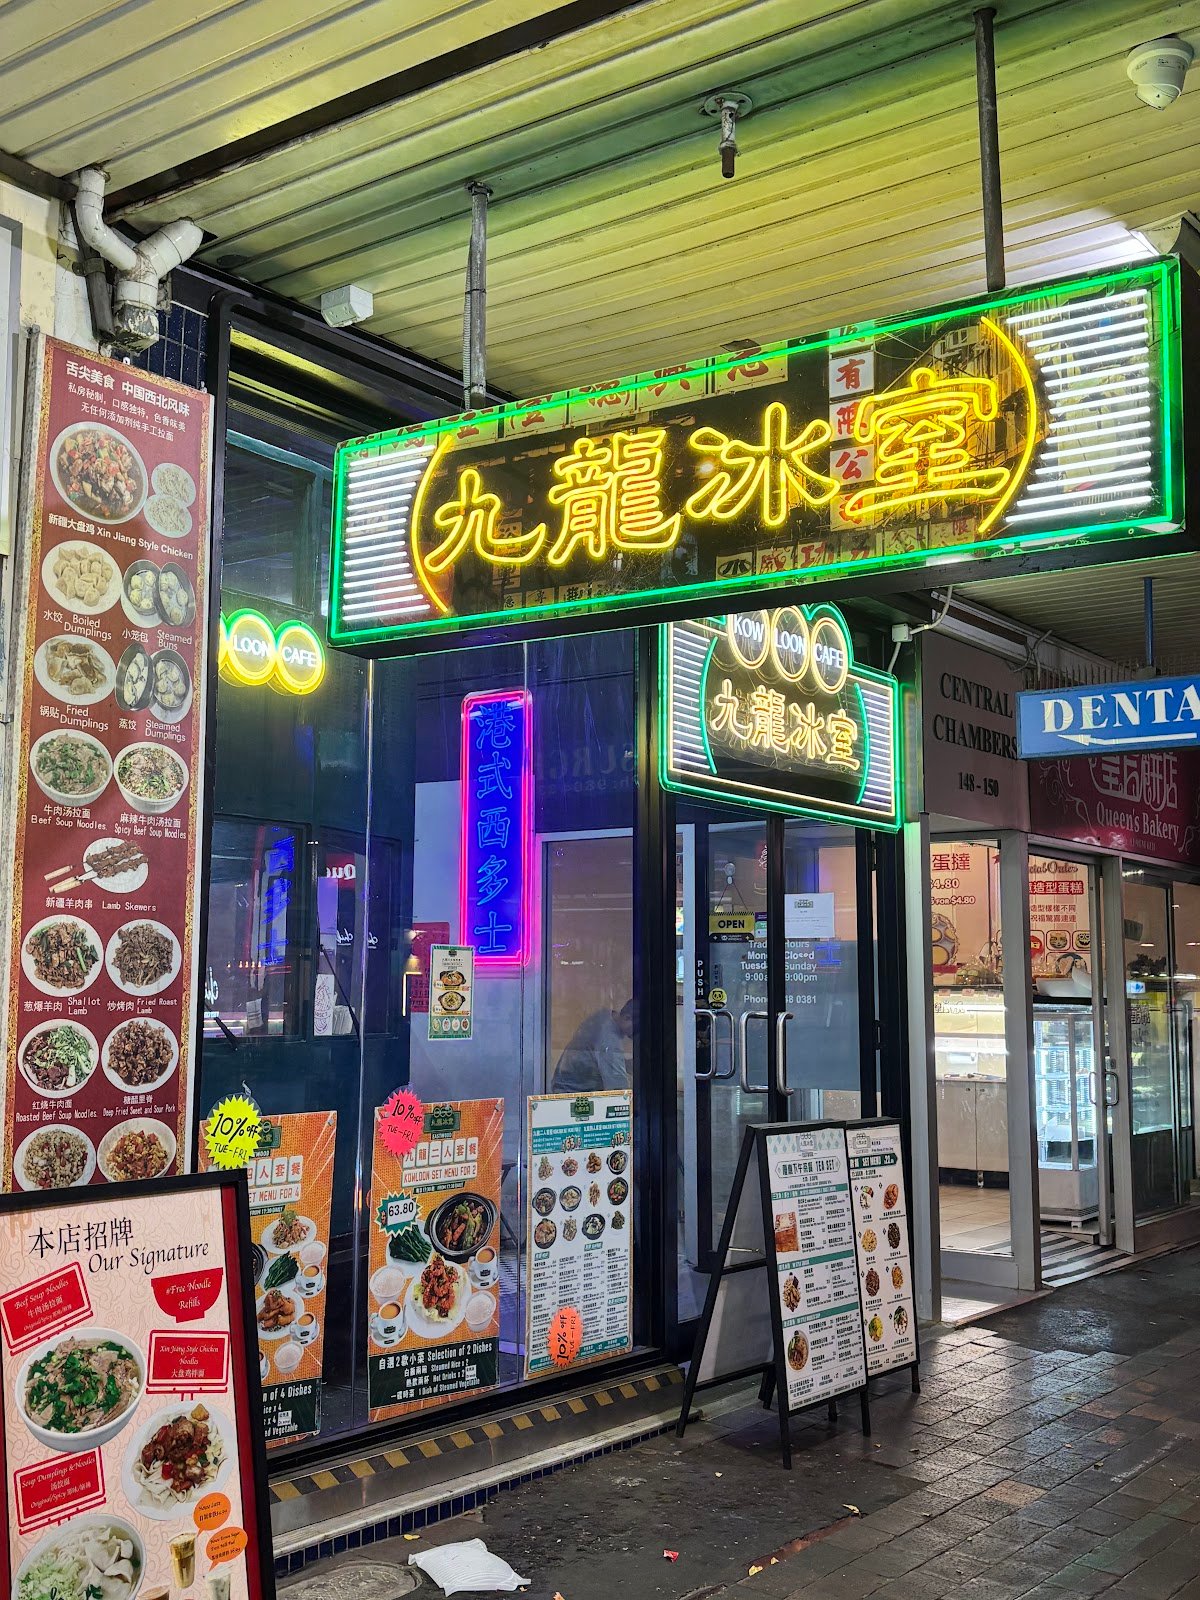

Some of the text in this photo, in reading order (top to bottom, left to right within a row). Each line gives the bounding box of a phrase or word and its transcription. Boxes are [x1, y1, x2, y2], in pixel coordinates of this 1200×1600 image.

[66, 360, 190, 417] 舌尖美食 中国西北风味
[80, 402, 174, 442] 无任何添加剂纯手工拉面
[424, 366, 1011, 573] 九龍冰室
[48, 513, 193, 560] 新疆大盘鸡 Xin Jiang Style Chicken
[43, 610, 63, 623] 水饺
[72, 614, 100, 628] Boiled
[63, 624, 112, 642] Dumplings
[121, 628, 148, 643] 小笼包
[157, 630, 192, 645] Steamed
[158, 639, 178, 651] Buns
[733, 614, 844, 669] KOW LOON CAFE
[233, 634, 317, 668] LOON CAFE
[940, 672, 1014, 719] CENTRAL
[39, 705, 60, 718] 锅贴
[66, 704, 89, 717] Fried
[60, 716, 109, 732] Dumplings
[118, 718, 137, 731] 蒸饺
[145, 719, 181, 733] Steamed
[711, 678, 860, 771] 九龍冰室
[145, 728, 186, 742] Dumplings
[933, 714, 1018, 760] CHAMBERS
[43, 804, 91, 819] 牛肉汤拉面
[31, 814, 52, 825] Beef
[55, 818, 74, 828] Soup
[119, 812, 181, 829] 麻辣牛肉汤拉面
[1096, 801, 1180, 846] Queen's Bakery
[114, 823, 187, 839] Spicy Beef Soup Noodles
[474, 701, 516, 955] 港式西多士
[45, 897, 157, 912] 新疆羊肉串 Lamb Skewers
[718, 920, 745, 929] OPEN
[748, 940, 767, 949] Trad
[747, 951, 767, 960] Mon
[740, 961, 817, 973] Tuesd Sunday
[785, 973, 818, 983] 9:00pm
[67, 996, 101, 1006] Shallot
[136, 997, 178, 1007] Fried Roast
[743, 995, 817, 1003] Phon 0381
[23, 1001, 63, 1012] 葱爆羊肉
[68, 1006, 88, 1015] Lamb
[107, 1001, 134, 1012] 炒烤肉
[136, 1007, 153, 1015] Lamb
[32, 1100, 73, 1110] 红烧牛肉面
[103, 1104, 176, 1117] Deep Fried Sweet and Sour Pork
[391, 1100, 415, 1121] 10%
[15, 1112, 40, 1122] Roasted
[42, 1110, 56, 1120] Beef
[58, 1110, 72, 1120] Soup
[211, 1113, 248, 1143] 10%
[815, 1159, 835, 1172] TEA SET
[404, 1164, 476, 1184] KOWLOON SET MENU FOR 2
[258, 1191, 277, 1202] MENU
[279, 1189, 292, 1199] FOR
[28, 1217, 134, 1259] 本店招牌
[88, 1241, 209, 1275] Our Signature
[187, 1278, 212, 1292] Noodle
[15, 1279, 69, 1309] Beef Soup Noodles
[179, 1296, 201, 1309] Refills
[160, 1344, 219, 1356] Xin Jiang Style Chicken
[427, 1348, 457, 1362] Selection
[458, 1346, 466, 1356] of
[472, 1342, 492, 1354] Dishes
[557, 1333, 569, 1360] 10%
[179, 1356, 199, 1365] Noodles
[270, 1388, 278, 1401] of
[287, 1384, 312, 1398] Dishes
[439, 1382, 458, 1392] Steamed
[22, 1456, 95, 1489] Soup Dumplings Noodles
